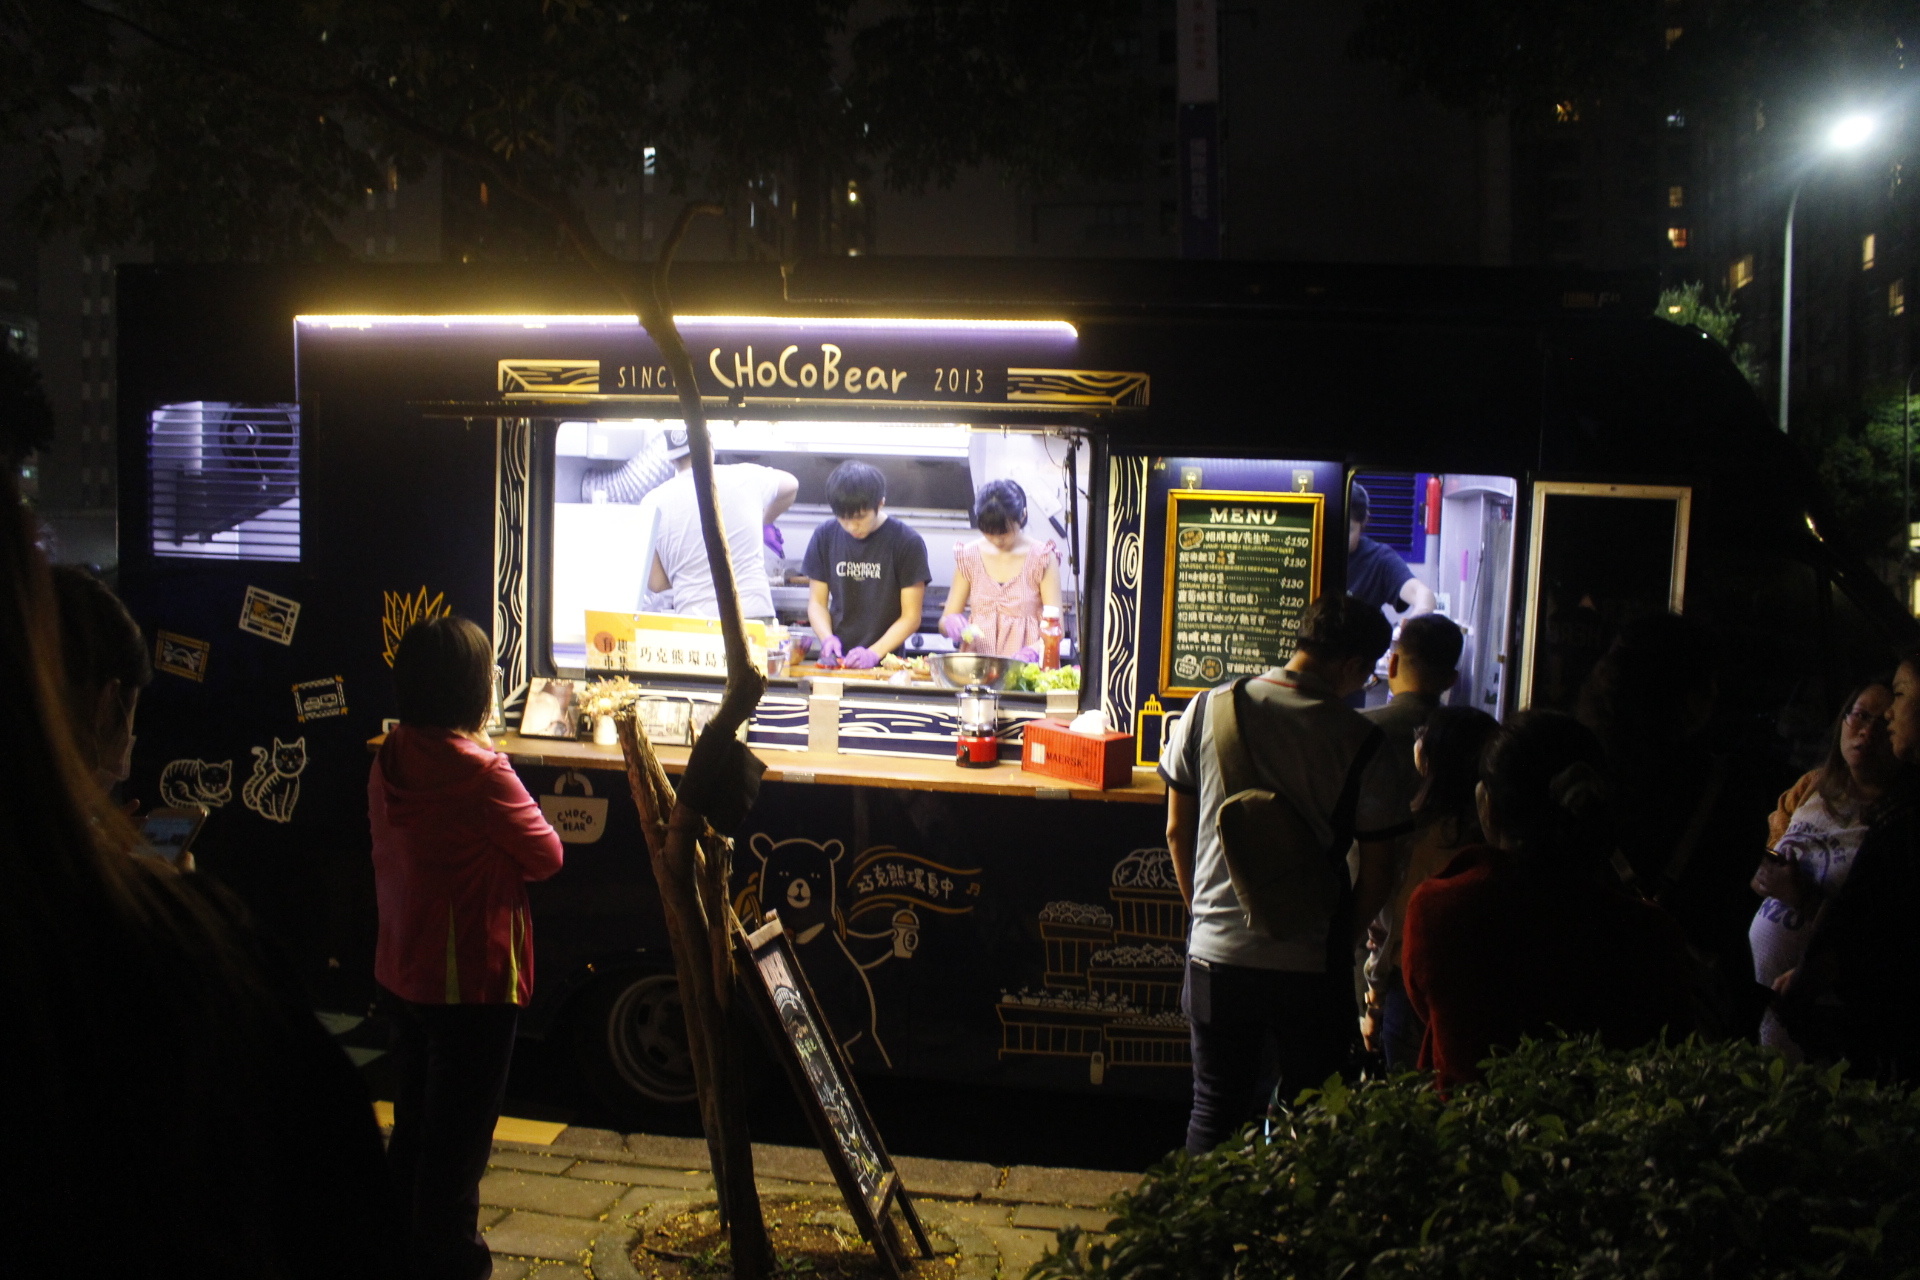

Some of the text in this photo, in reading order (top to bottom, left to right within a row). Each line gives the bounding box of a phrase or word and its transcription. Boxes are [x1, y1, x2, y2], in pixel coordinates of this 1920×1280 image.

[618, 366, 677, 389] SINC
[935, 368, 984, 394] 2013
[1209, 507, 1278, 525] MENU
[1284, 535, 1309, 548] $150
[1283, 555, 1307, 568] $130
[1280, 577, 1304, 589] $130
[1280, 594, 1305, 608] $120
[1281, 617, 1301, 630] $60
[1177, 644, 1199, 652] CRAFT
[1046, 752, 1083, 768] MAERSK
[557, 809, 593, 824] CHOCO
[562, 822, 586, 831] BEAR
[857, 863, 955, 900] 巧克熊環島中
